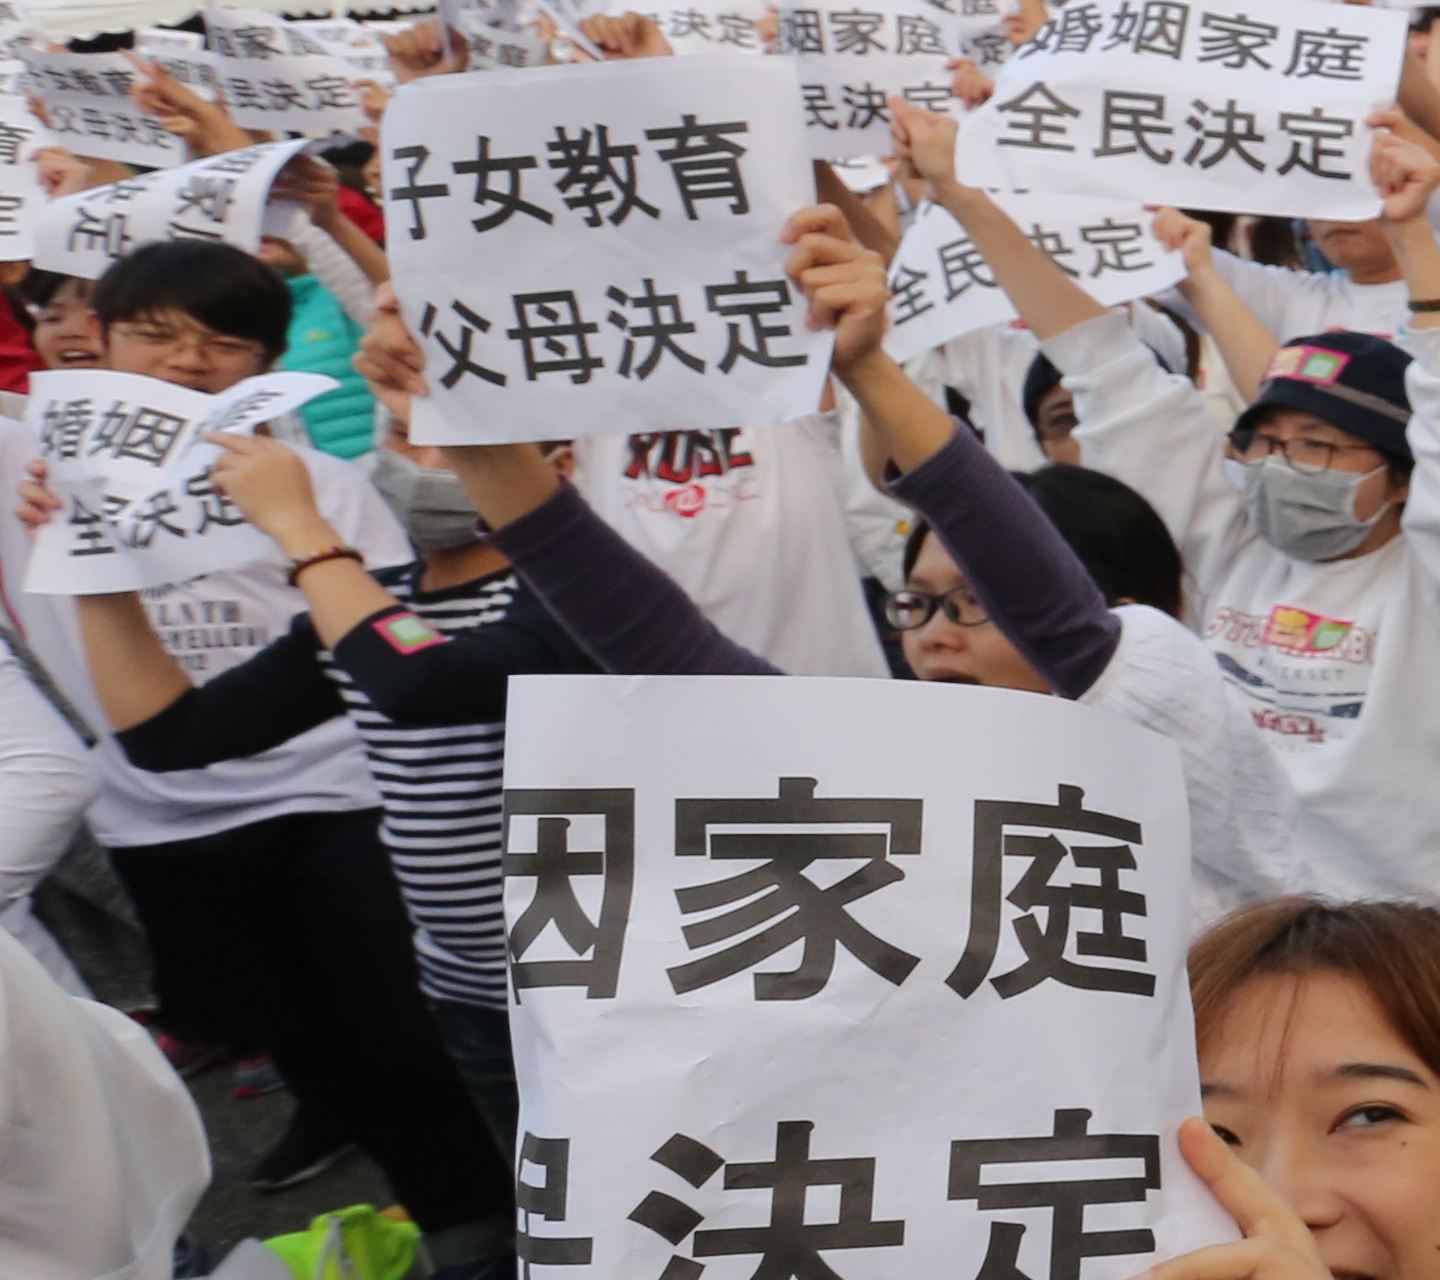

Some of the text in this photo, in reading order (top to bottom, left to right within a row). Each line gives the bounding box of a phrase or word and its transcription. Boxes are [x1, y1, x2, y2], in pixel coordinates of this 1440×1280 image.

[389, 114, 752, 241] 子女教育
[997, 79, 1356, 182] 全民決定
[419, 269, 810, 391] 父母決定
